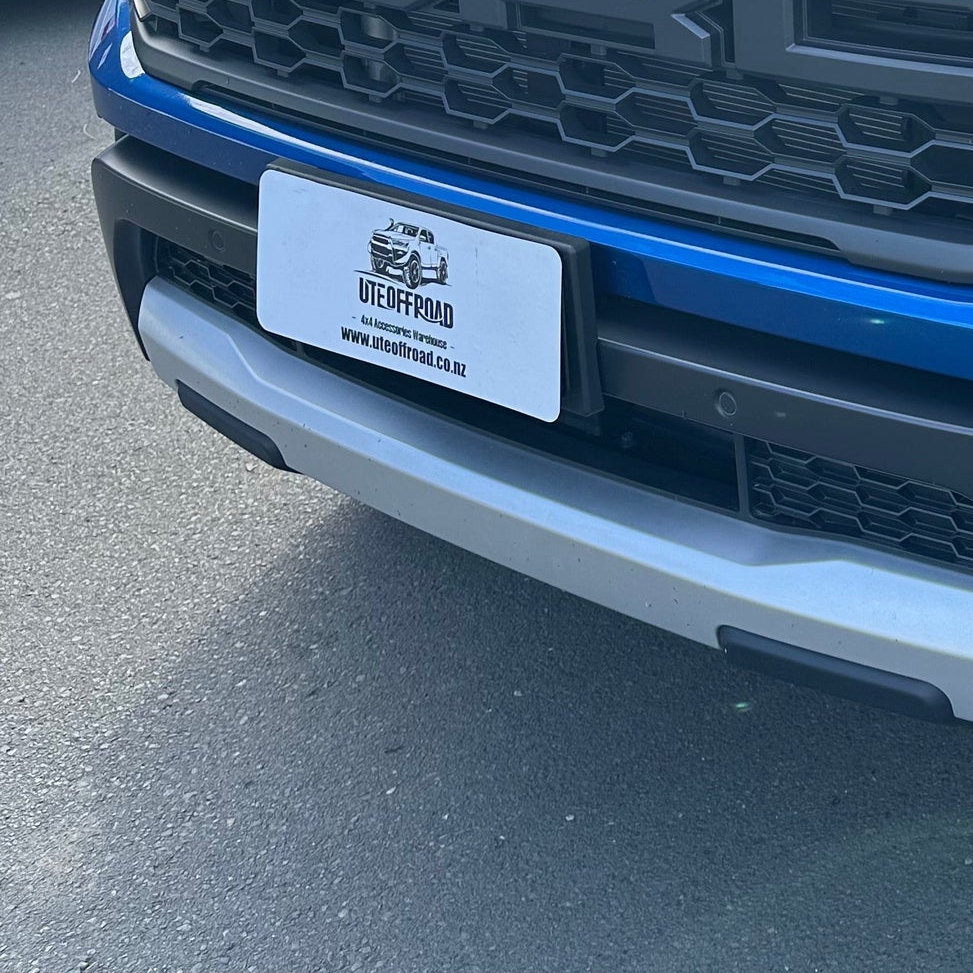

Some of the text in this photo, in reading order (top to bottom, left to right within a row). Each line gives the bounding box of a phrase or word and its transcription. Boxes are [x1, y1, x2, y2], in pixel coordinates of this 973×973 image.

[359, 278, 453, 329] UTEOFFROAD
[341, 327, 466, 377] www.uteoffroad.co.nz
[360, 314, 447, 350] 4x4 Accessories Warehouse
